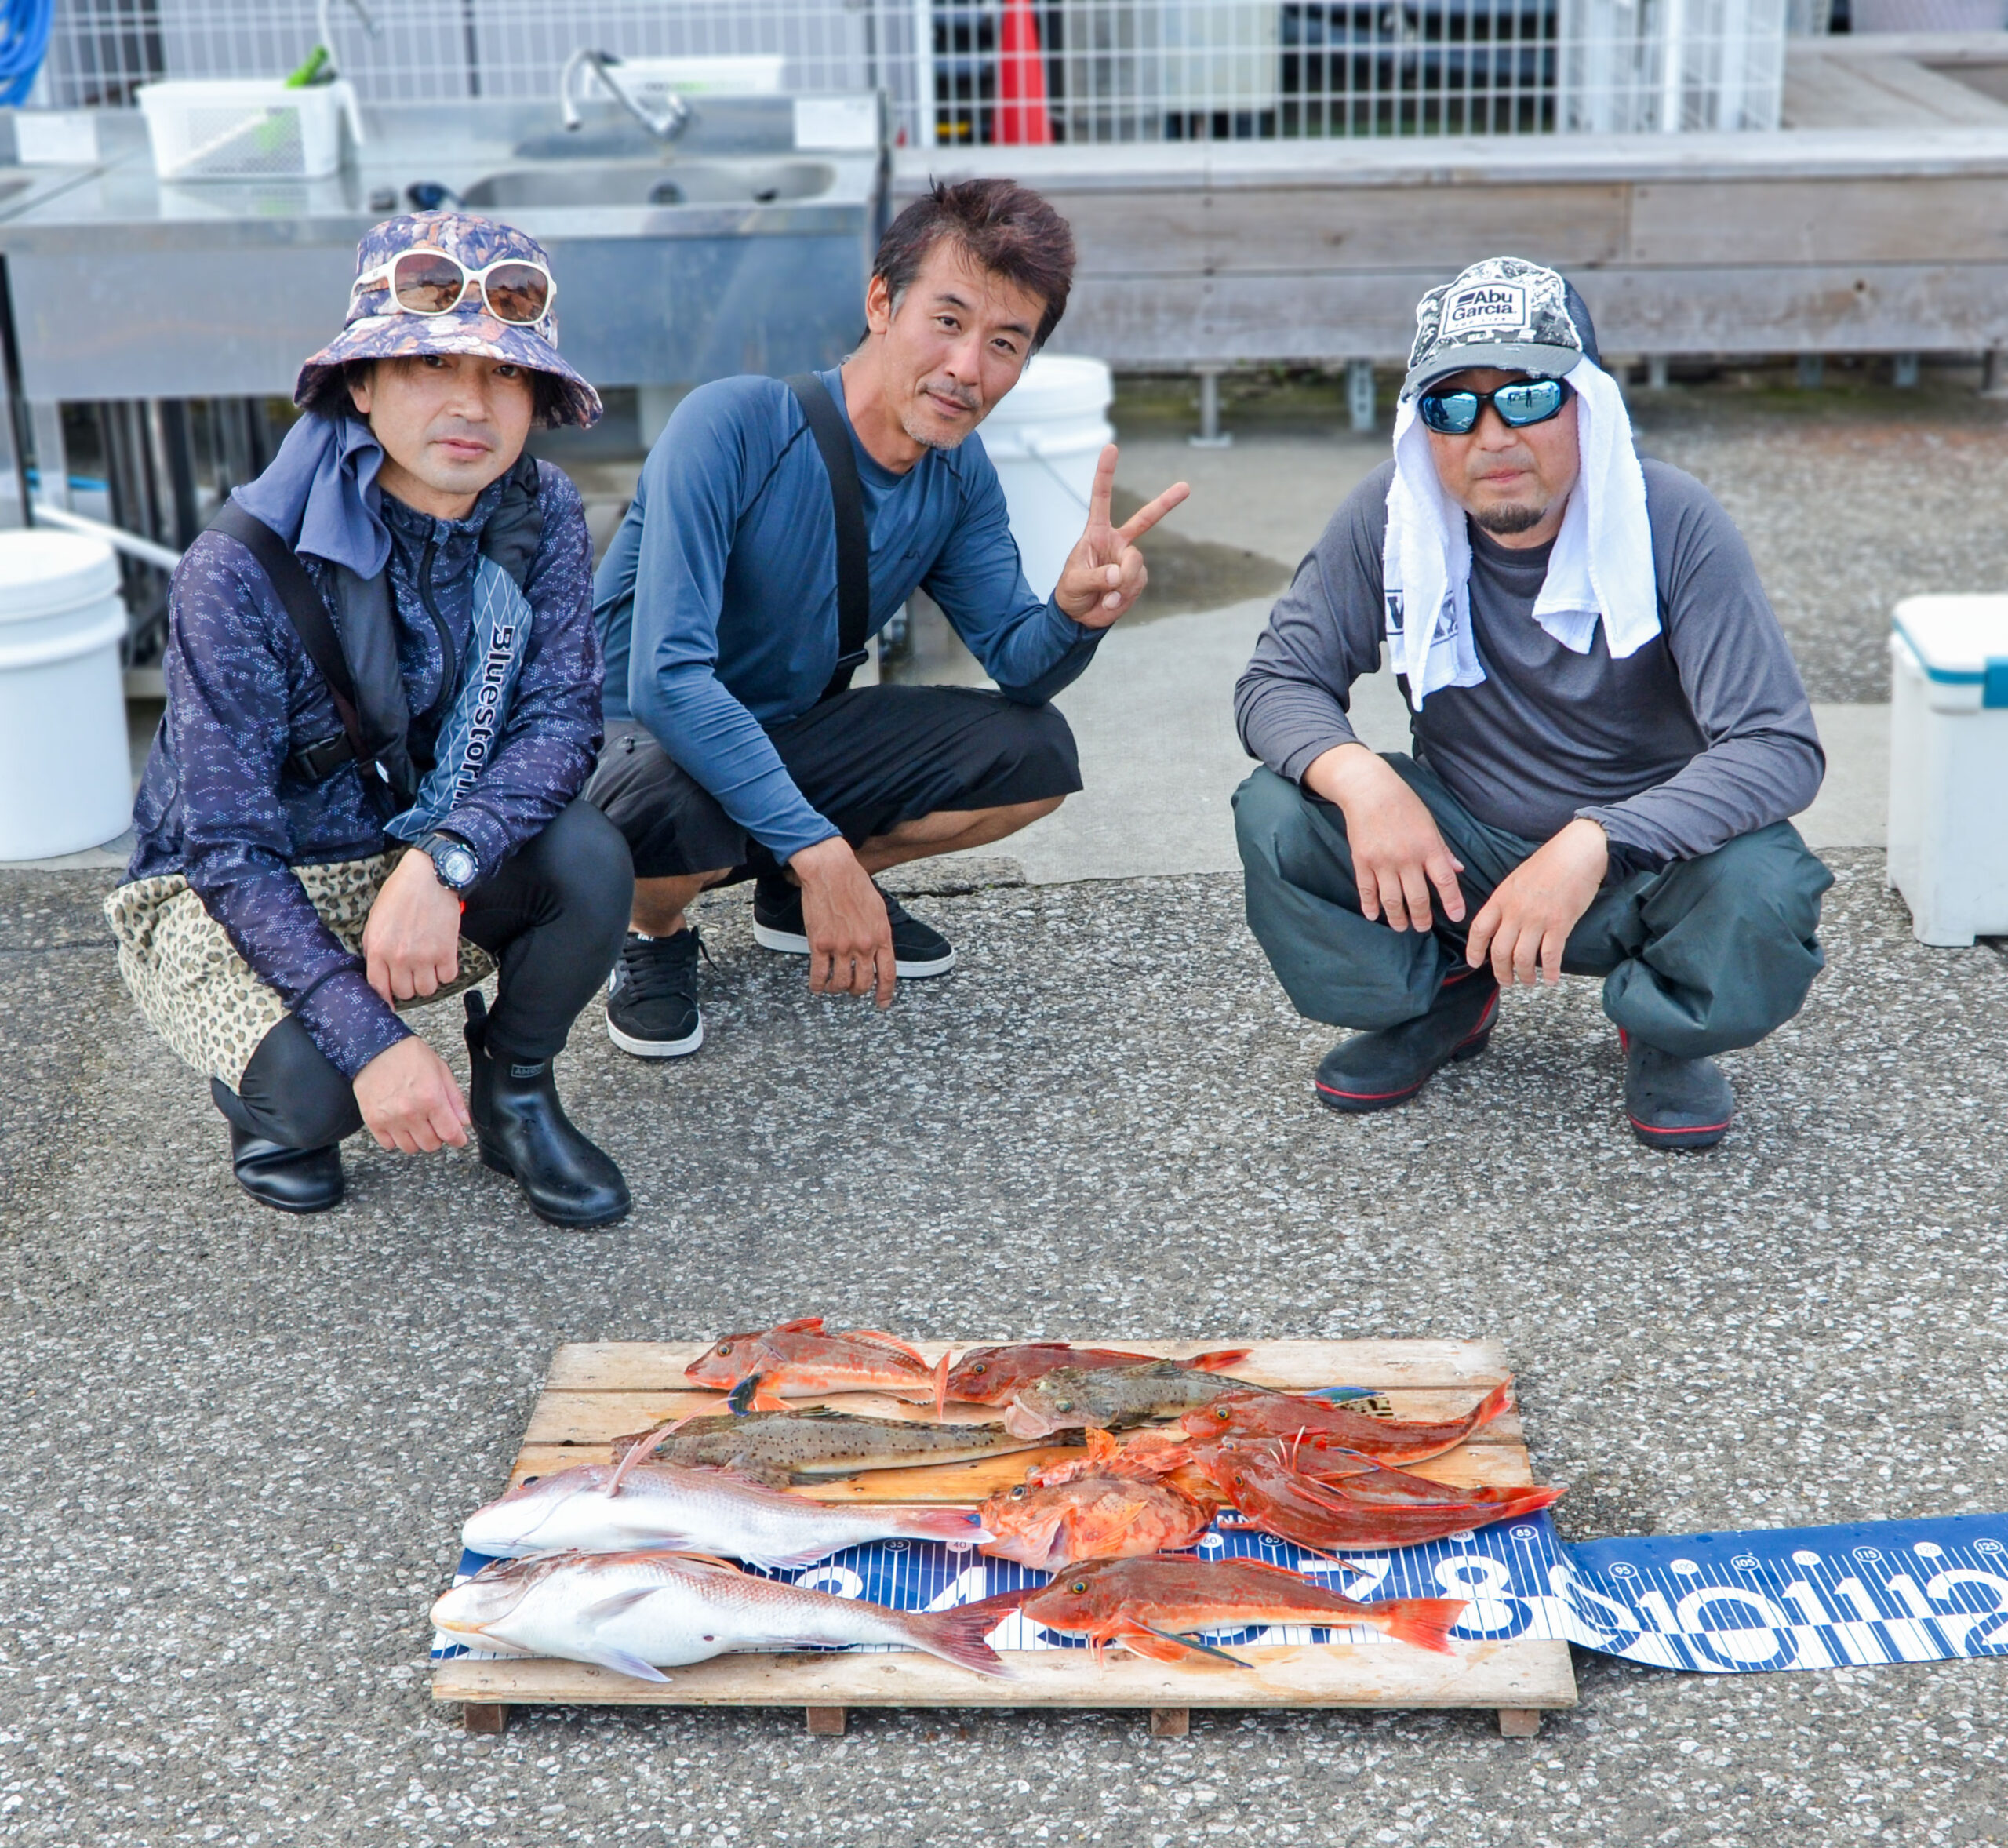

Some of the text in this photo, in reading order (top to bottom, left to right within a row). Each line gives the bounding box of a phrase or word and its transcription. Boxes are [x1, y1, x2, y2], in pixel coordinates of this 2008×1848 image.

[1474, 289, 1512, 304] Abu
[1453, 304, 1513, 321] Garcia
[1265, 1535, 1280, 1544] 65
[1516, 1529, 1532, 1537] 85
[1614, 1566, 1632, 1575] 95
[1736, 1558, 1755, 1568] 105
[1857, 1550, 1877, 1559] 115
[1977, 1543, 1998, 1552] 125
[1434, 1555, 1533, 1641] 8
[1635, 1586, 1799, 1672] 10
